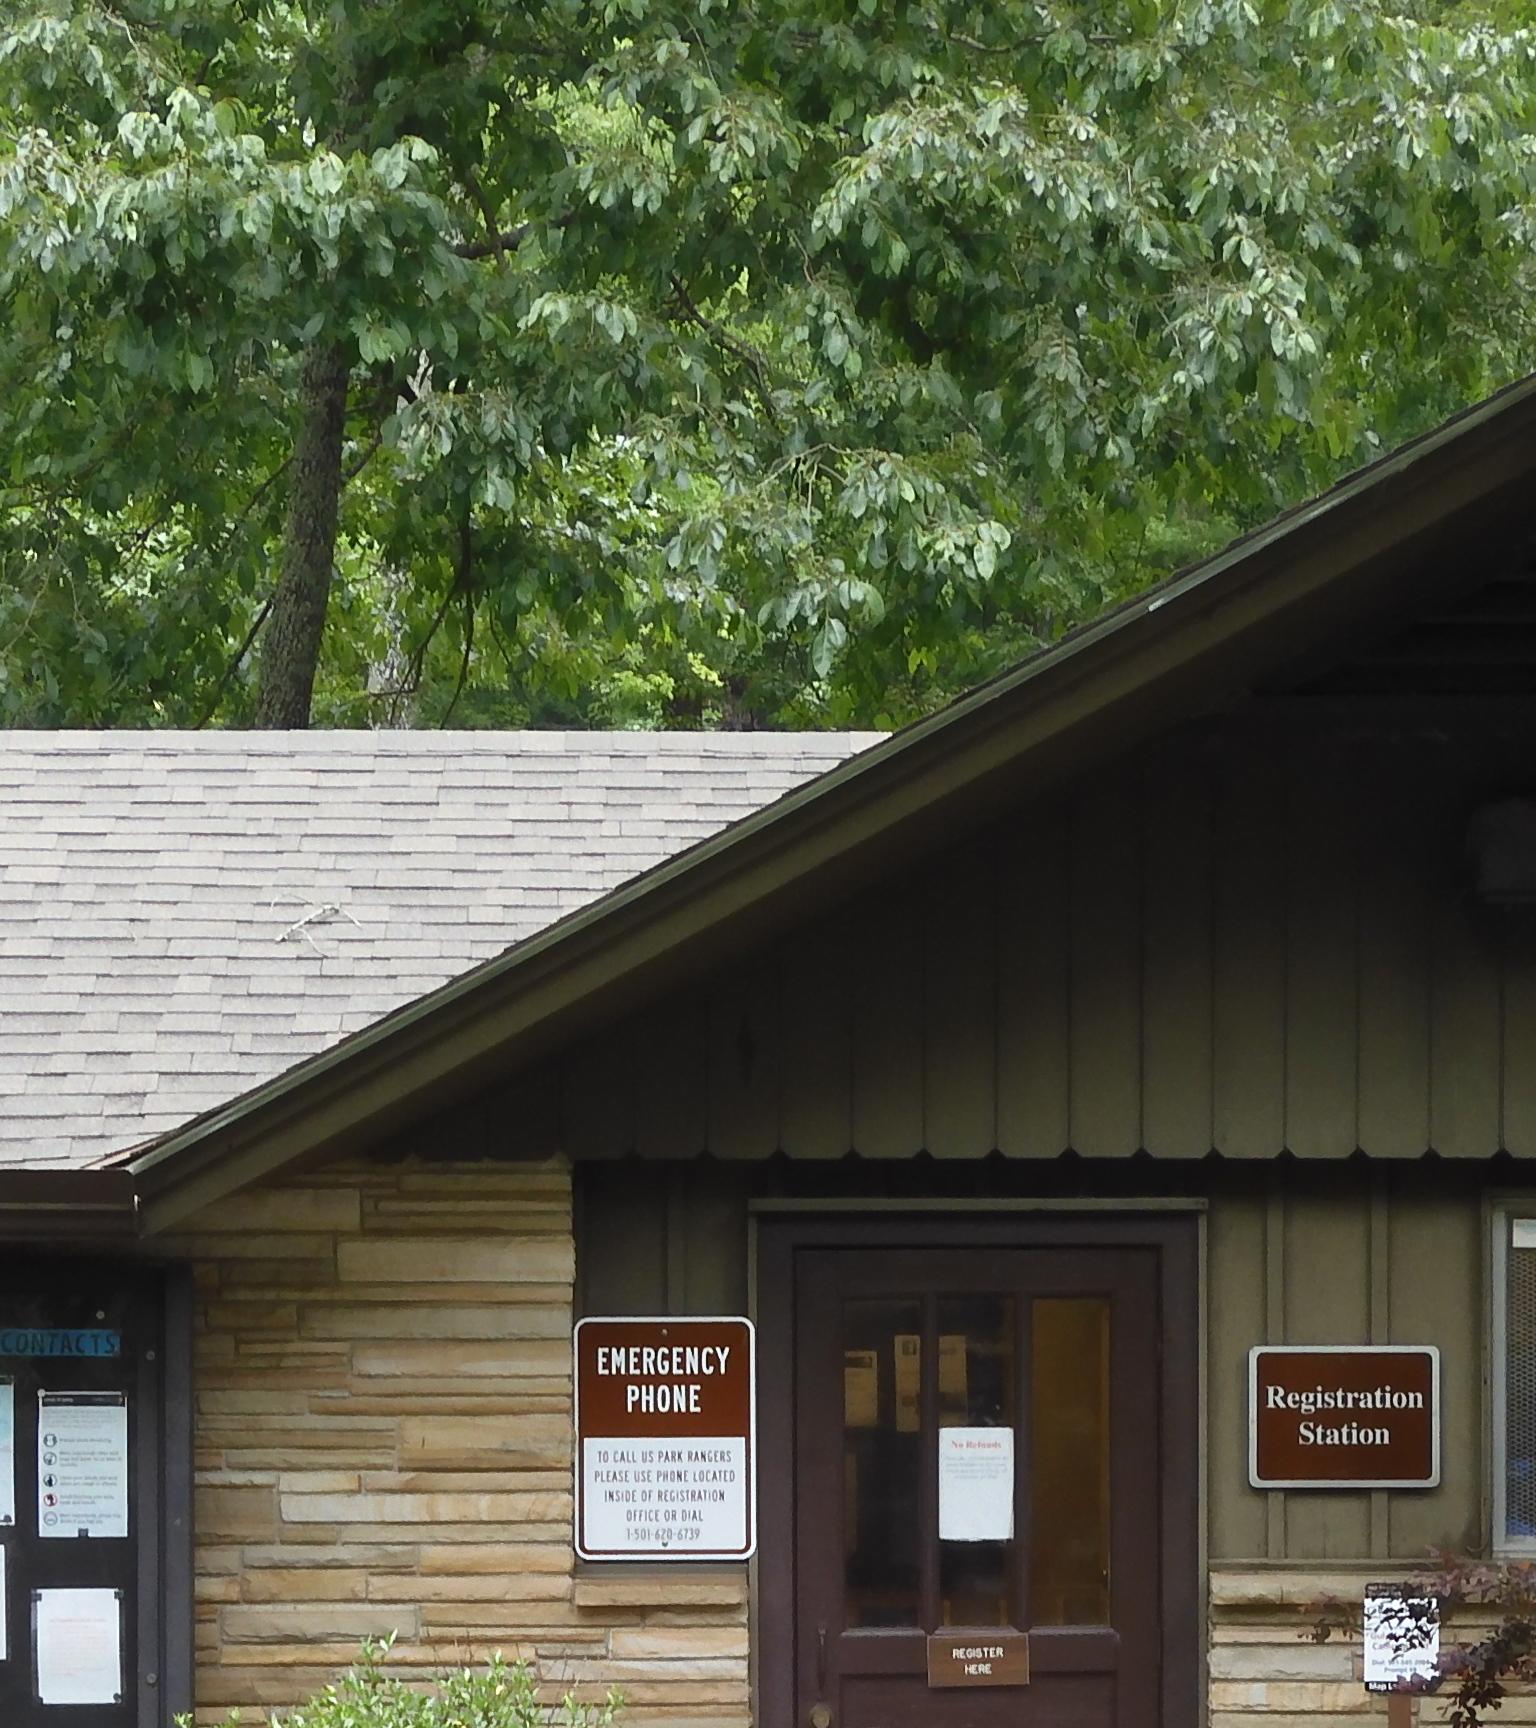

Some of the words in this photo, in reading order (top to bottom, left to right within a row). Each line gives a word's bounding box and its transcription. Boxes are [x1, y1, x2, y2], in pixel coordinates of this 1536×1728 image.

[0, 1331, 116, 1355] CONTACTS
[597, 1346, 730, 1376] EMERGENCY
[627, 1384, 702, 1413] PHONE
[1266, 1385, 1424, 1415] Registration
[1298, 1421, 1390, 1445] Station
[597, 1450, 609, 1463] TO
[613, 1450, 637, 1463] CALL
[641, 1450, 654, 1463] US
[658, 1450, 683, 1463] PARK
[687, 1450, 732, 1463] RANGERS
[594, 1470, 629, 1483] PLEASE
[633, 1470, 652, 1483] USE
[656, 1470, 688, 1483] PHONE
[693, 1470, 736, 1483] LOCATED
[604, 1489, 637, 1502] INSIDE
[641, 1489, 653, 1502] OF
[657, 1489, 725, 1502] REGISTRATION
[626, 1509, 660, 1522] OFFICE
[664, 1509, 677, 1522] OR
[681, 1509, 704, 1522] DIAL
[626, 1528, 701, 1541] 1-501-620-6739
[952, 1646, 1004, 1659] REGISTER
[964, 1663, 993, 1675] HERE
[1368, 1682, 1387, 1691] Map
